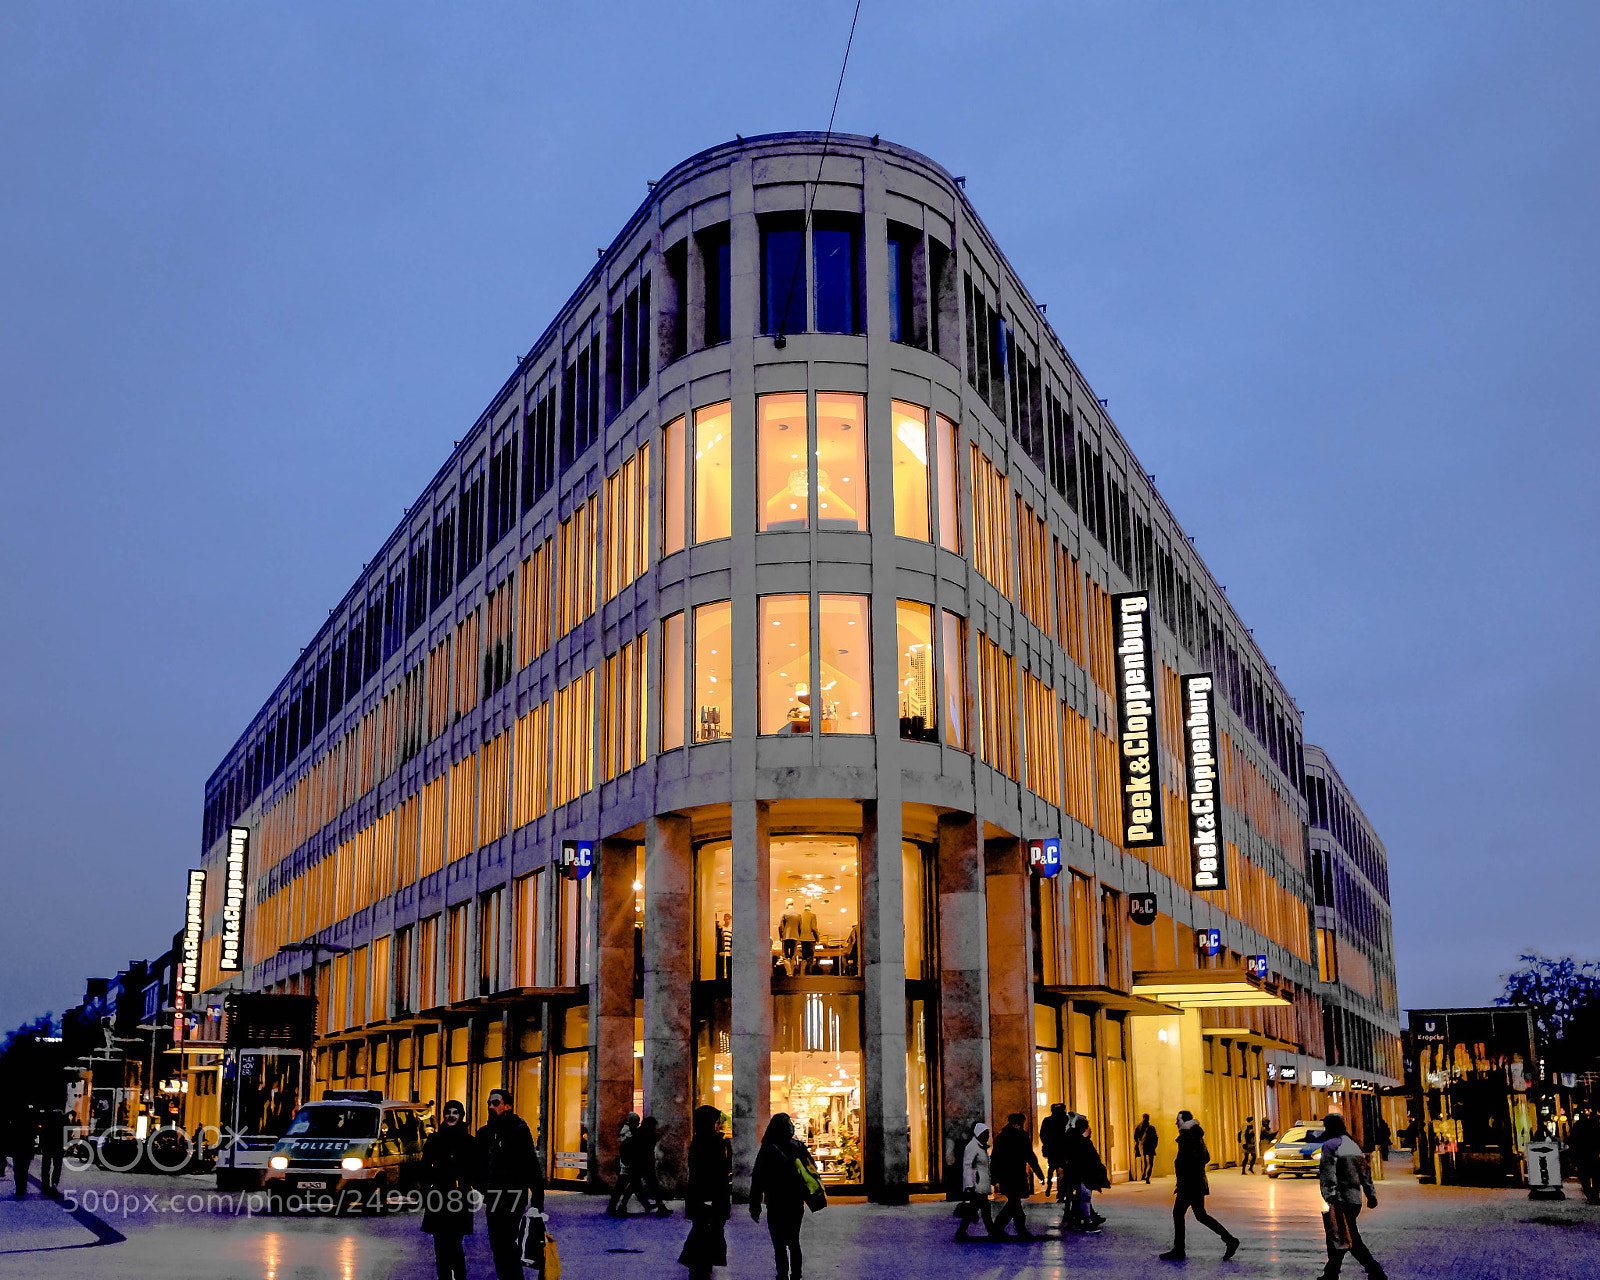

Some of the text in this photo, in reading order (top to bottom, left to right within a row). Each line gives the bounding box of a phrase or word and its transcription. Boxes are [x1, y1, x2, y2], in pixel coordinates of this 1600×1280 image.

[1118, 596, 1154, 842] Peek&Cloppenburg
[1186, 676, 1219, 888] Peek&Cloppenburg
[564, 847, 591, 867] P&C
[1030, 845, 1058, 865] P&C
[221, 828, 248, 969] Peek&Cloppenburg
[1131, 898, 1154, 914] P&C
[181, 870, 206, 992] Peek&Cloppenburg
[1198, 933, 1219, 947] P&C
[1248, 958, 1266, 971] P&C
[290, 1142, 349, 1150] POLIZEI
